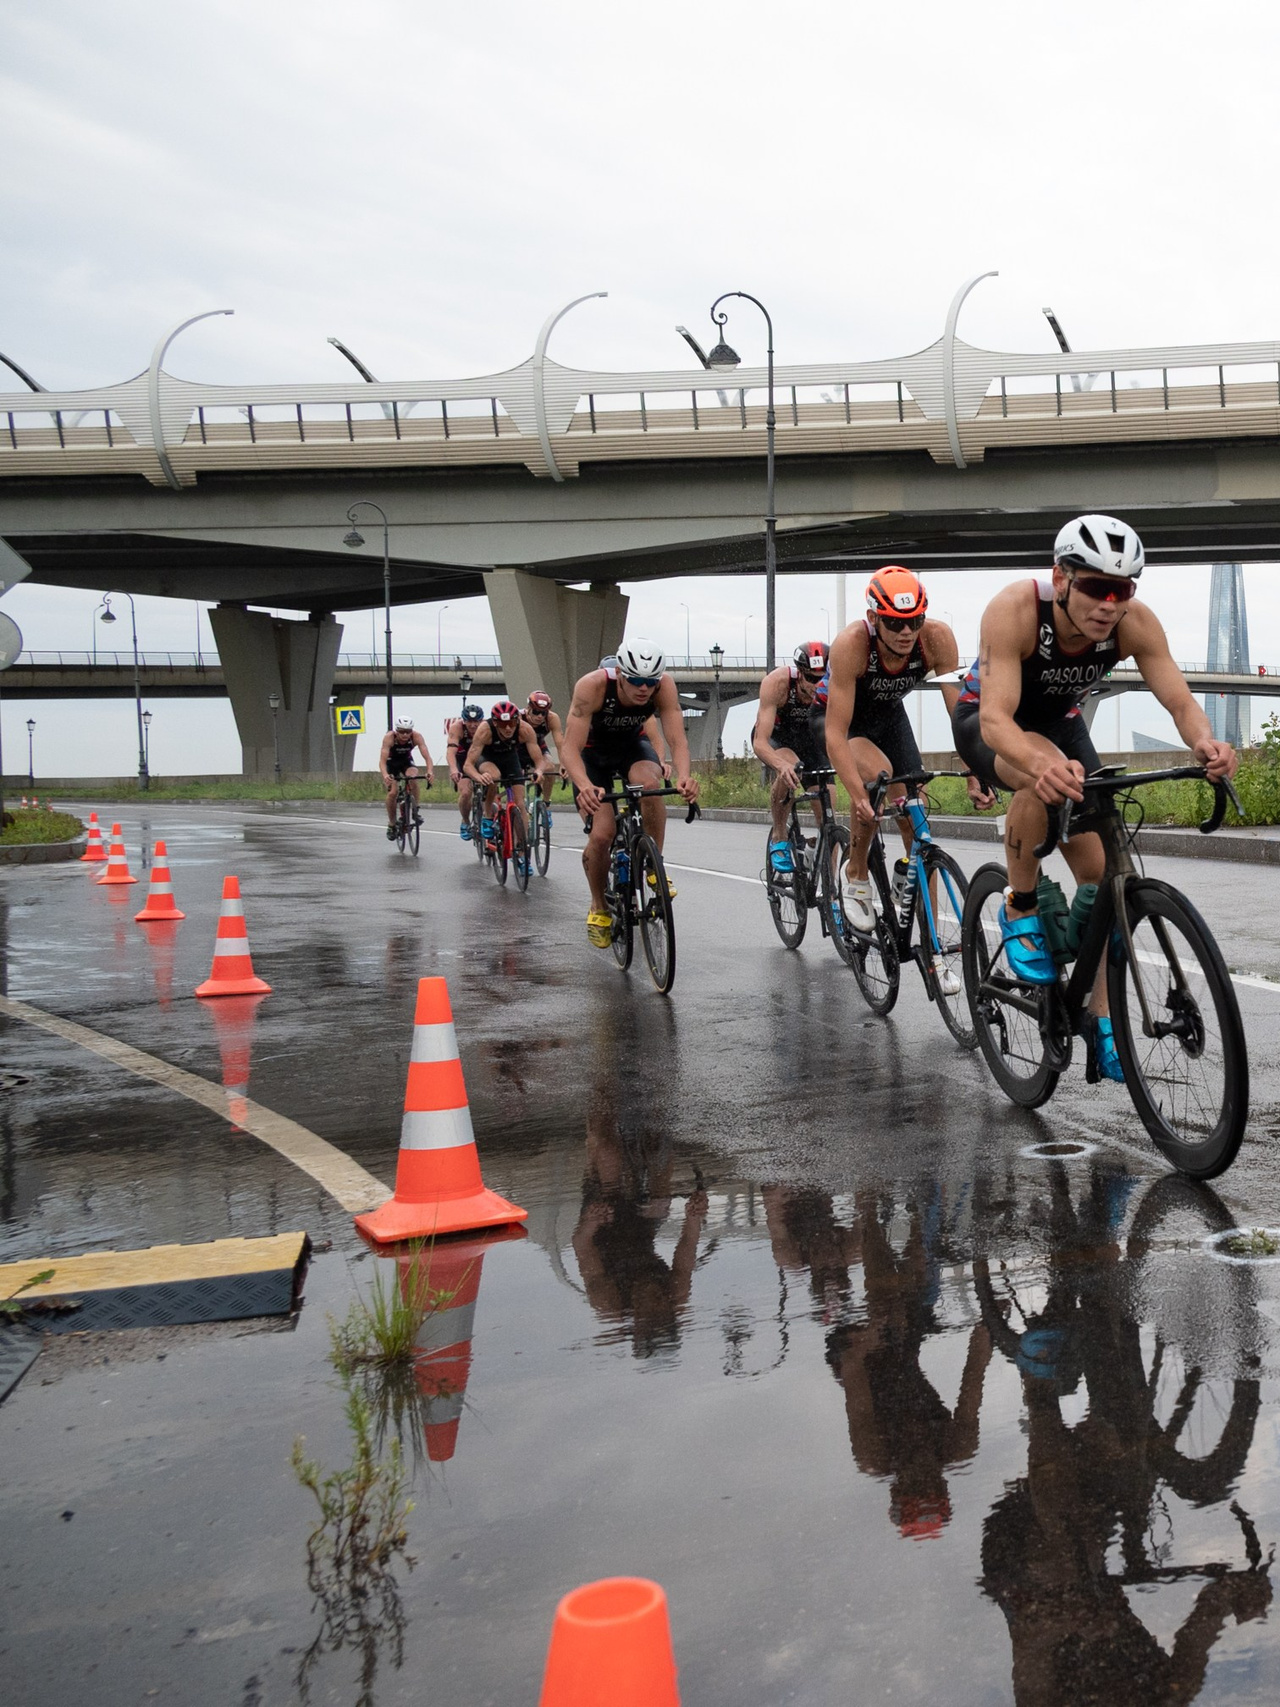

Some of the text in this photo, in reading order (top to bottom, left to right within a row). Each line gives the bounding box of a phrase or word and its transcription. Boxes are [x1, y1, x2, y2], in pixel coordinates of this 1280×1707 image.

[1115, 560, 1121, 569] 4
[869, 677, 916, 691] KASHITSYN
[1043, 686, 1083, 695] RUS
[874, 692, 902, 700] RUS
[1008, 826, 1022, 860] 4
